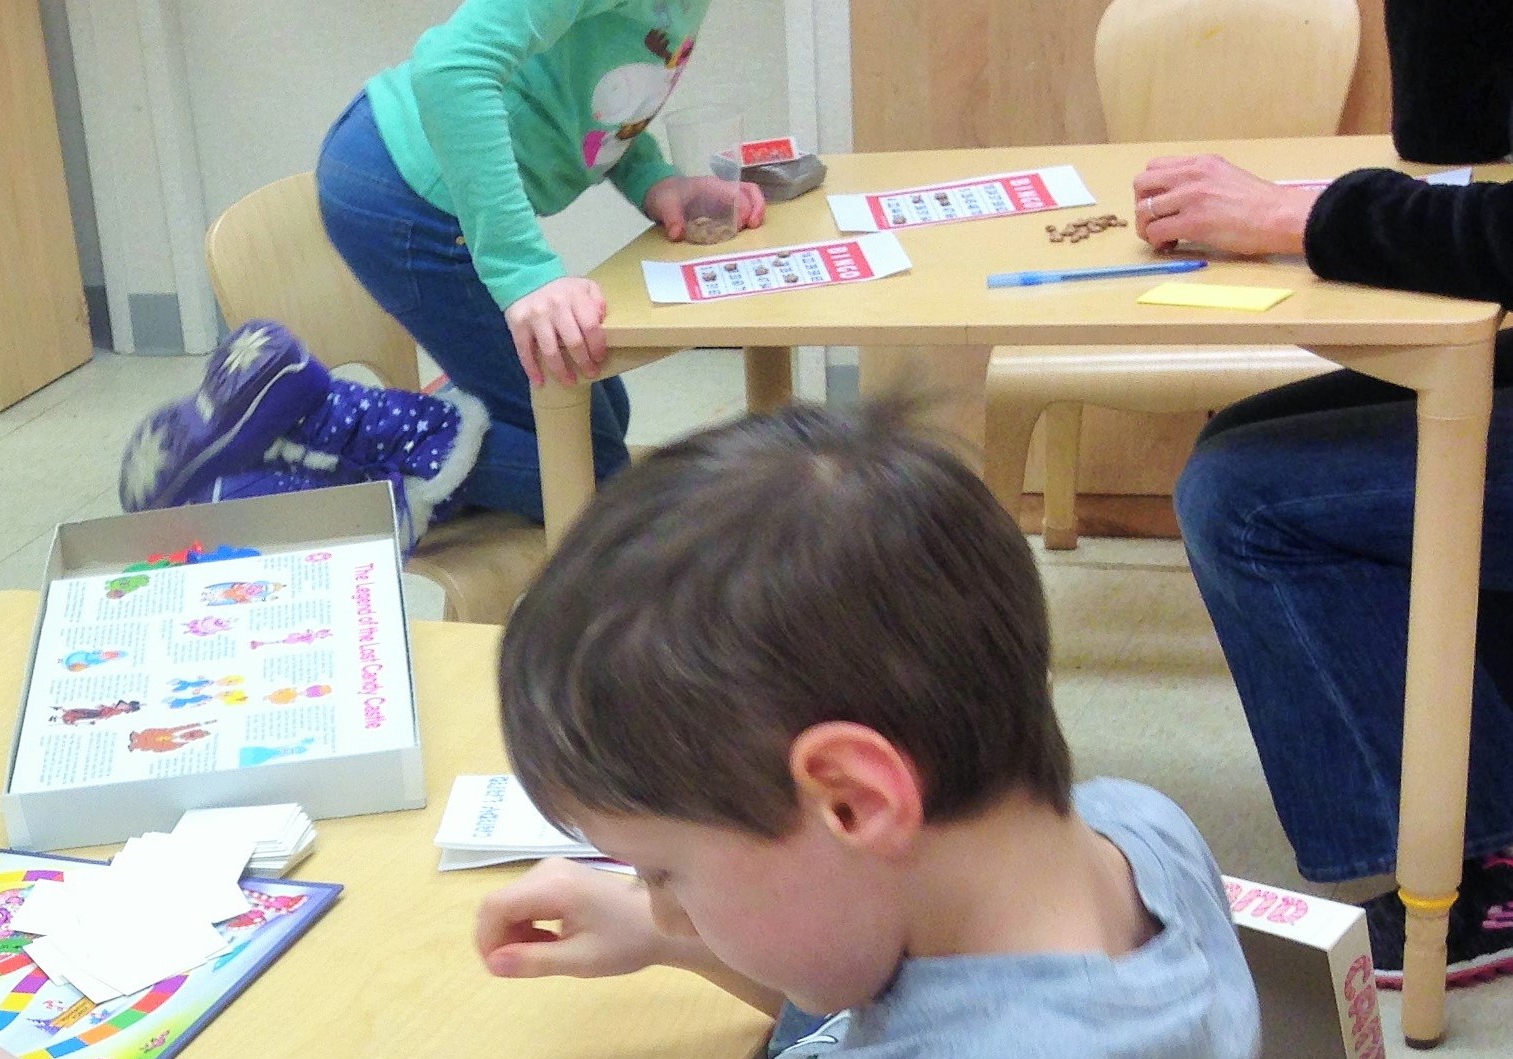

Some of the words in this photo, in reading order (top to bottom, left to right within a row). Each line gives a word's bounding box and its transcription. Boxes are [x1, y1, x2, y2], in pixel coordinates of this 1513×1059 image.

[354, 562, 375, 582] The
[351, 582, 377, 616] Legend
[357, 616, 379, 626] of
[359, 642, 381, 663] Lost
[356, 663, 385, 695] Candy
[363, 696, 387, 730] Castle
